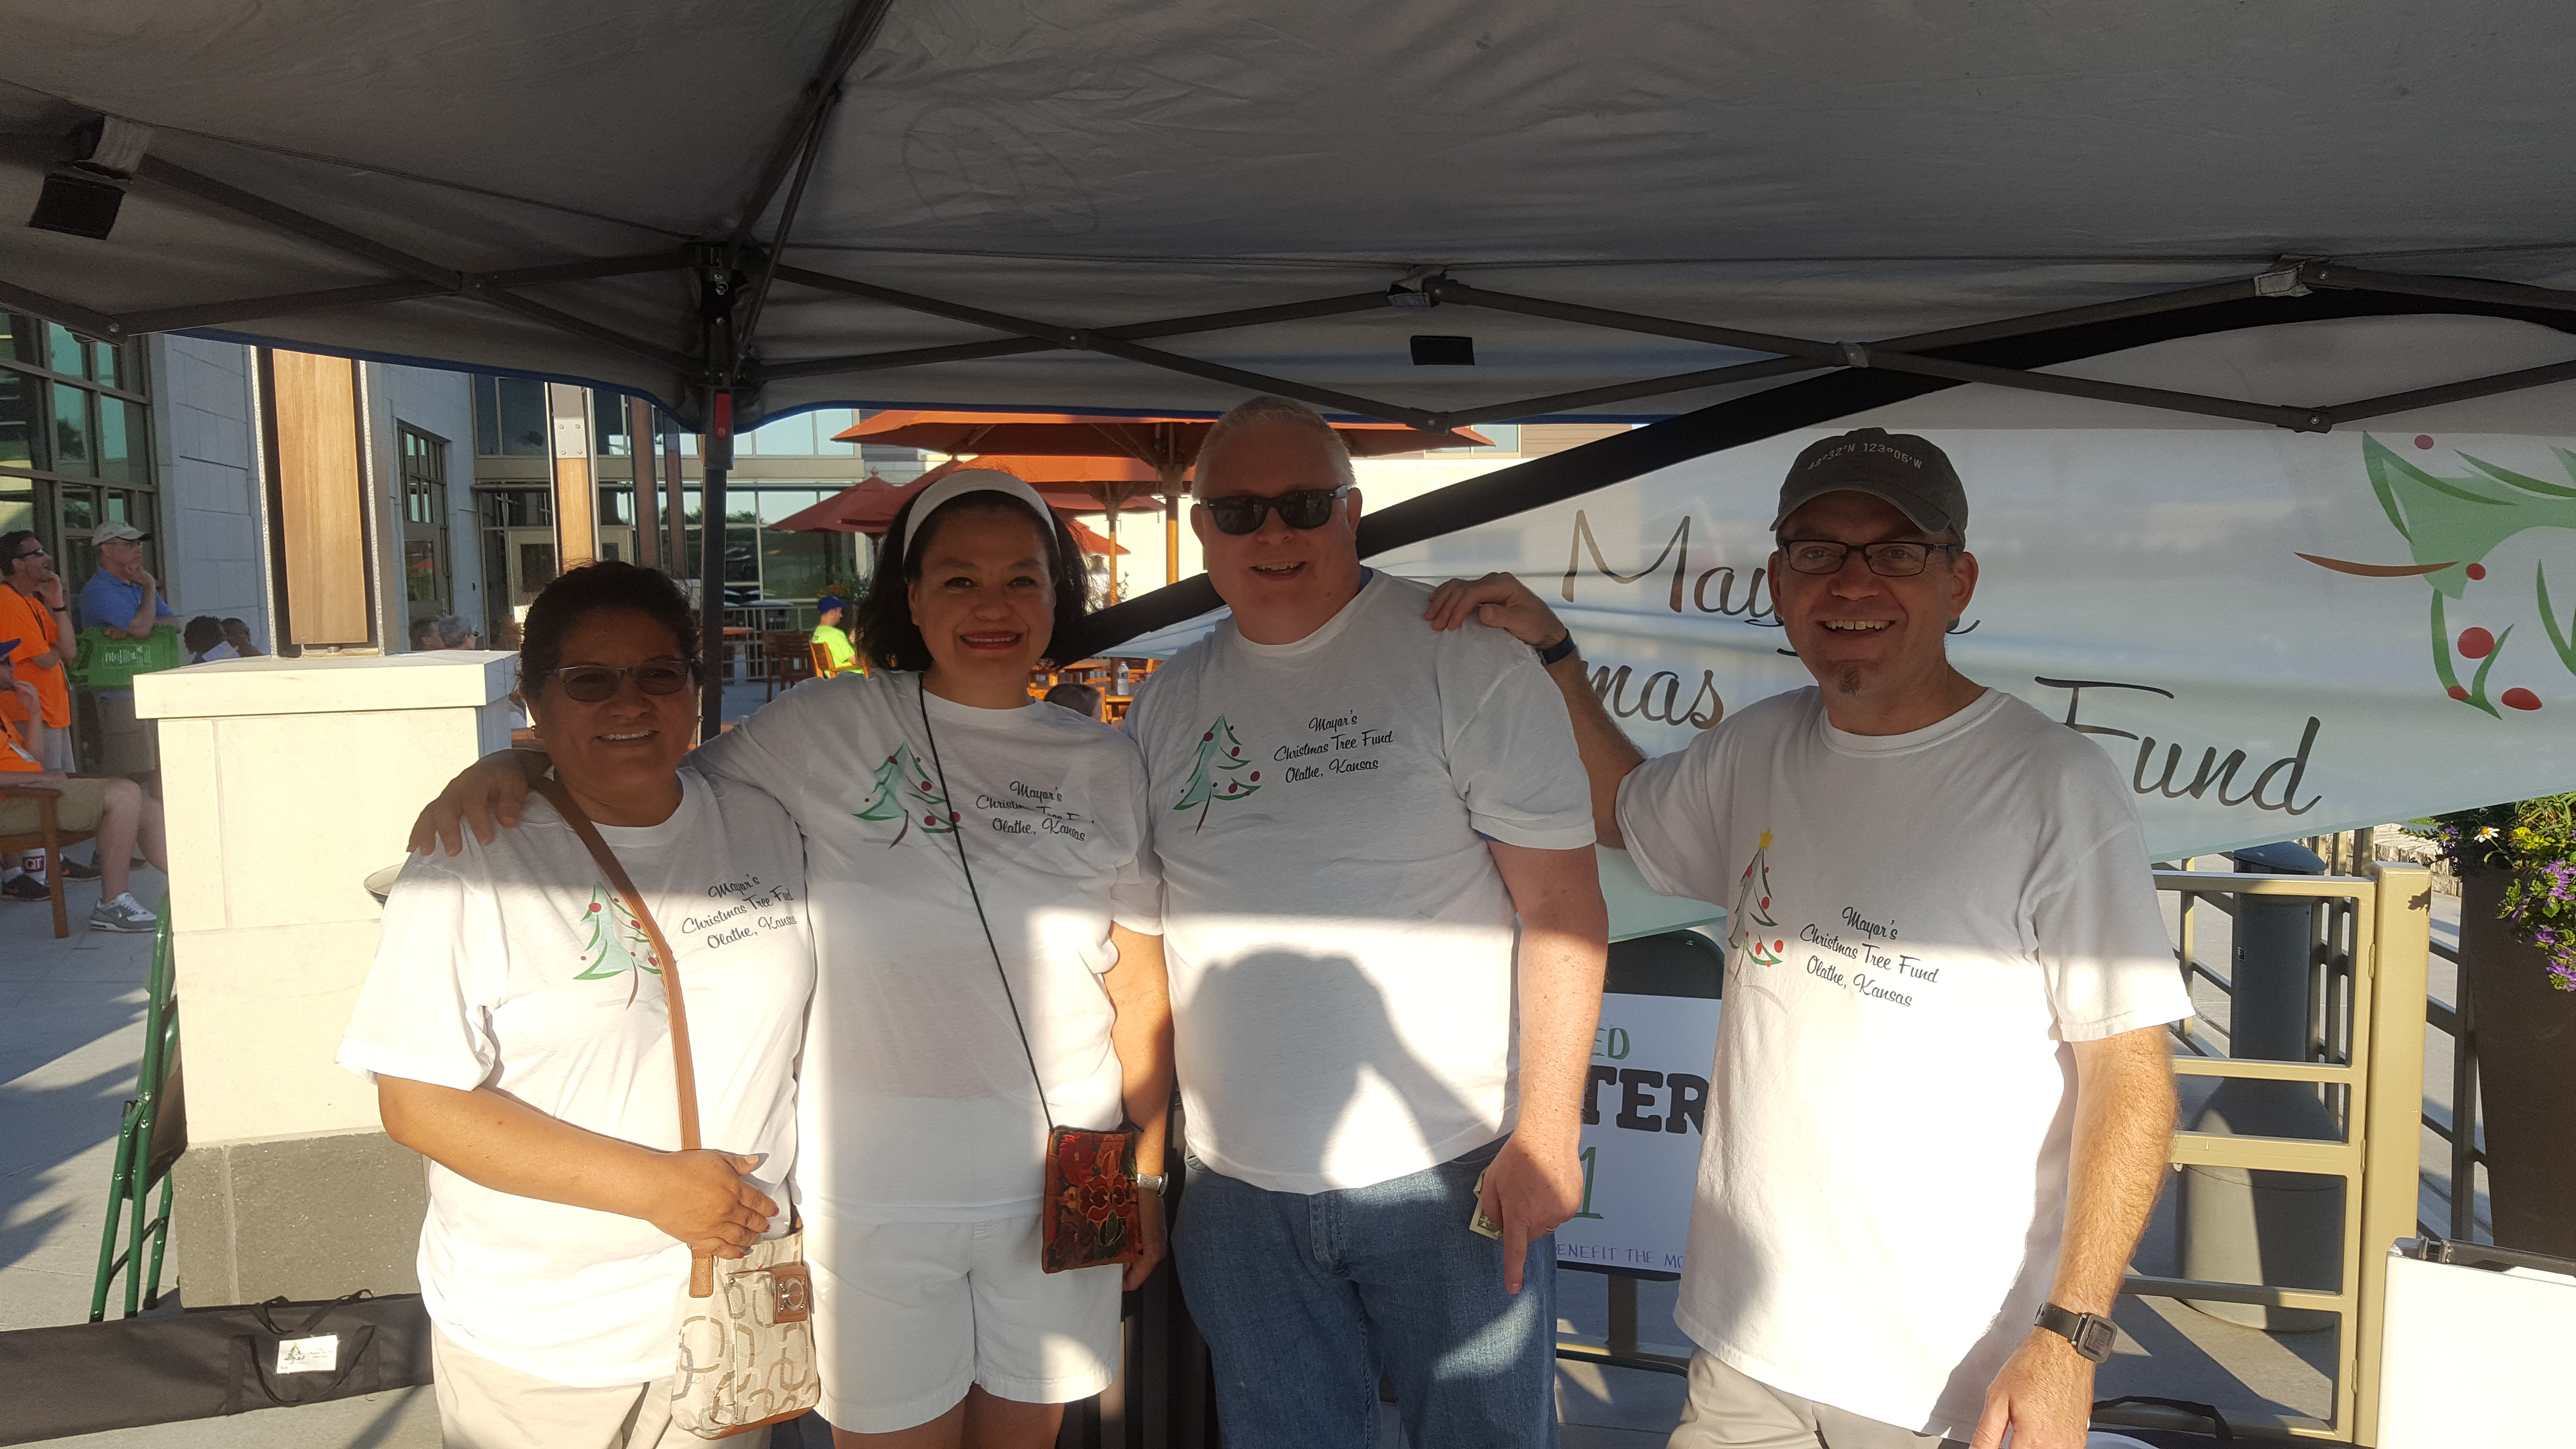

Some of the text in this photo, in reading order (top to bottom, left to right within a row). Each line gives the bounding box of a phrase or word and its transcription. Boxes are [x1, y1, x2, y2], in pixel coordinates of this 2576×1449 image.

[1582, 660, 1724, 729] mas
[1308, 709, 1357, 732] Mayor's
[1273, 729, 1393, 761] Christmas Tree Fund
[1285, 758, 1379, 783] Olathe, Kansas
[1009, 780, 1063, 803] Mayor's
[992, 817, 1086, 841] Olathe, Kansas
[708, 873, 760, 898] Mayor's
[681, 904, 748, 934] Christmas
[742, 894, 773, 910] Tree
[1842, 906, 1898, 940] Mayor's
[707, 927, 758, 949] Olathe,
[1800, 923, 1939, 983] Christmas Tree Fund
[1807, 955, 1913, 1007] Olathe, Kansas
[1592, 1027, 1630, 1060] ED
[1582, 1064, 1709, 1136] TER
[1555, 1244, 1618, 1260] ENEFIT
[1625, 1248, 1654, 1263] THE
